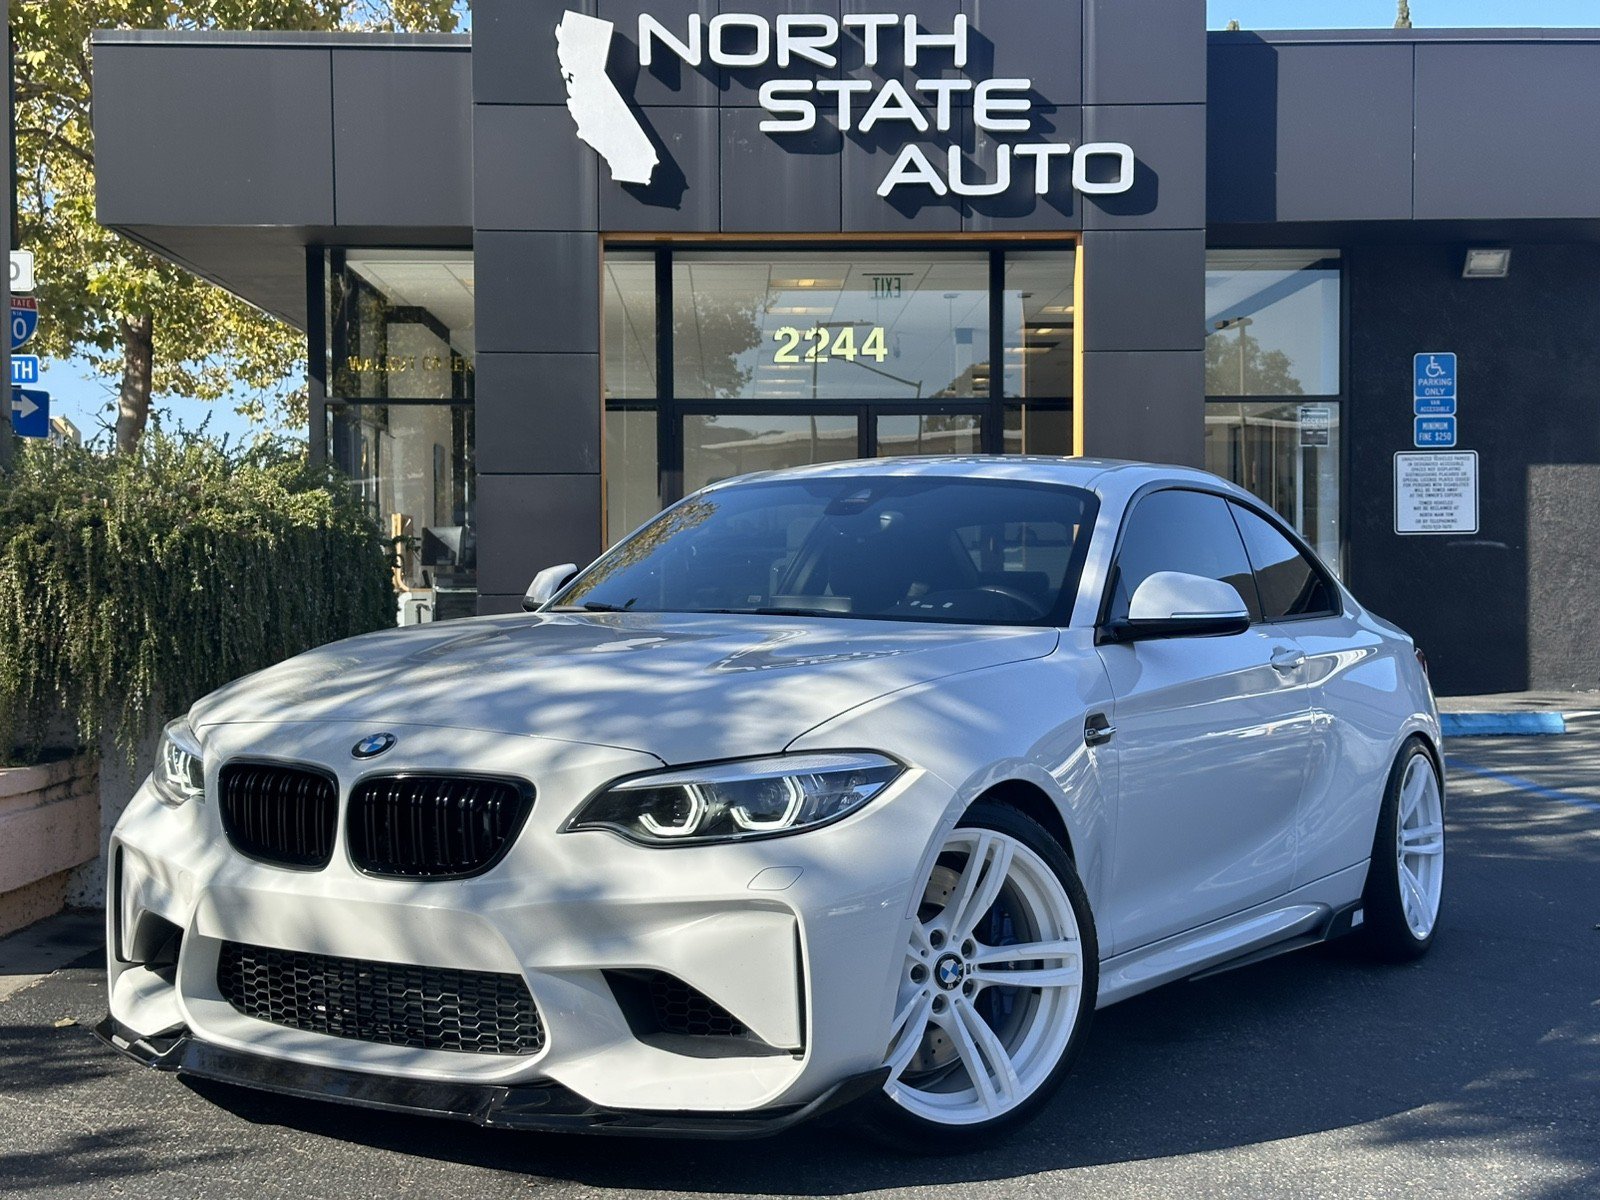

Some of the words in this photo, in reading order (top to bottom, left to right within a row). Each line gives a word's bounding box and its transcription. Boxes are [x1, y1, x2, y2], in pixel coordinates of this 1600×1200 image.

[638, 13, 967, 68] NORTH
[759, 78, 1031, 133] STATE
[877, 142, 1135, 197] AUTO
[773, 326, 888, 363] 2244
[1417, 378, 1453, 386] PARKING
[1424, 388, 1446, 396] ONLY
[1418, 432, 1432, 441] FINE
[1435, 432, 1452, 442] $250
[1422, 422, 1449, 430] MINIMUM
